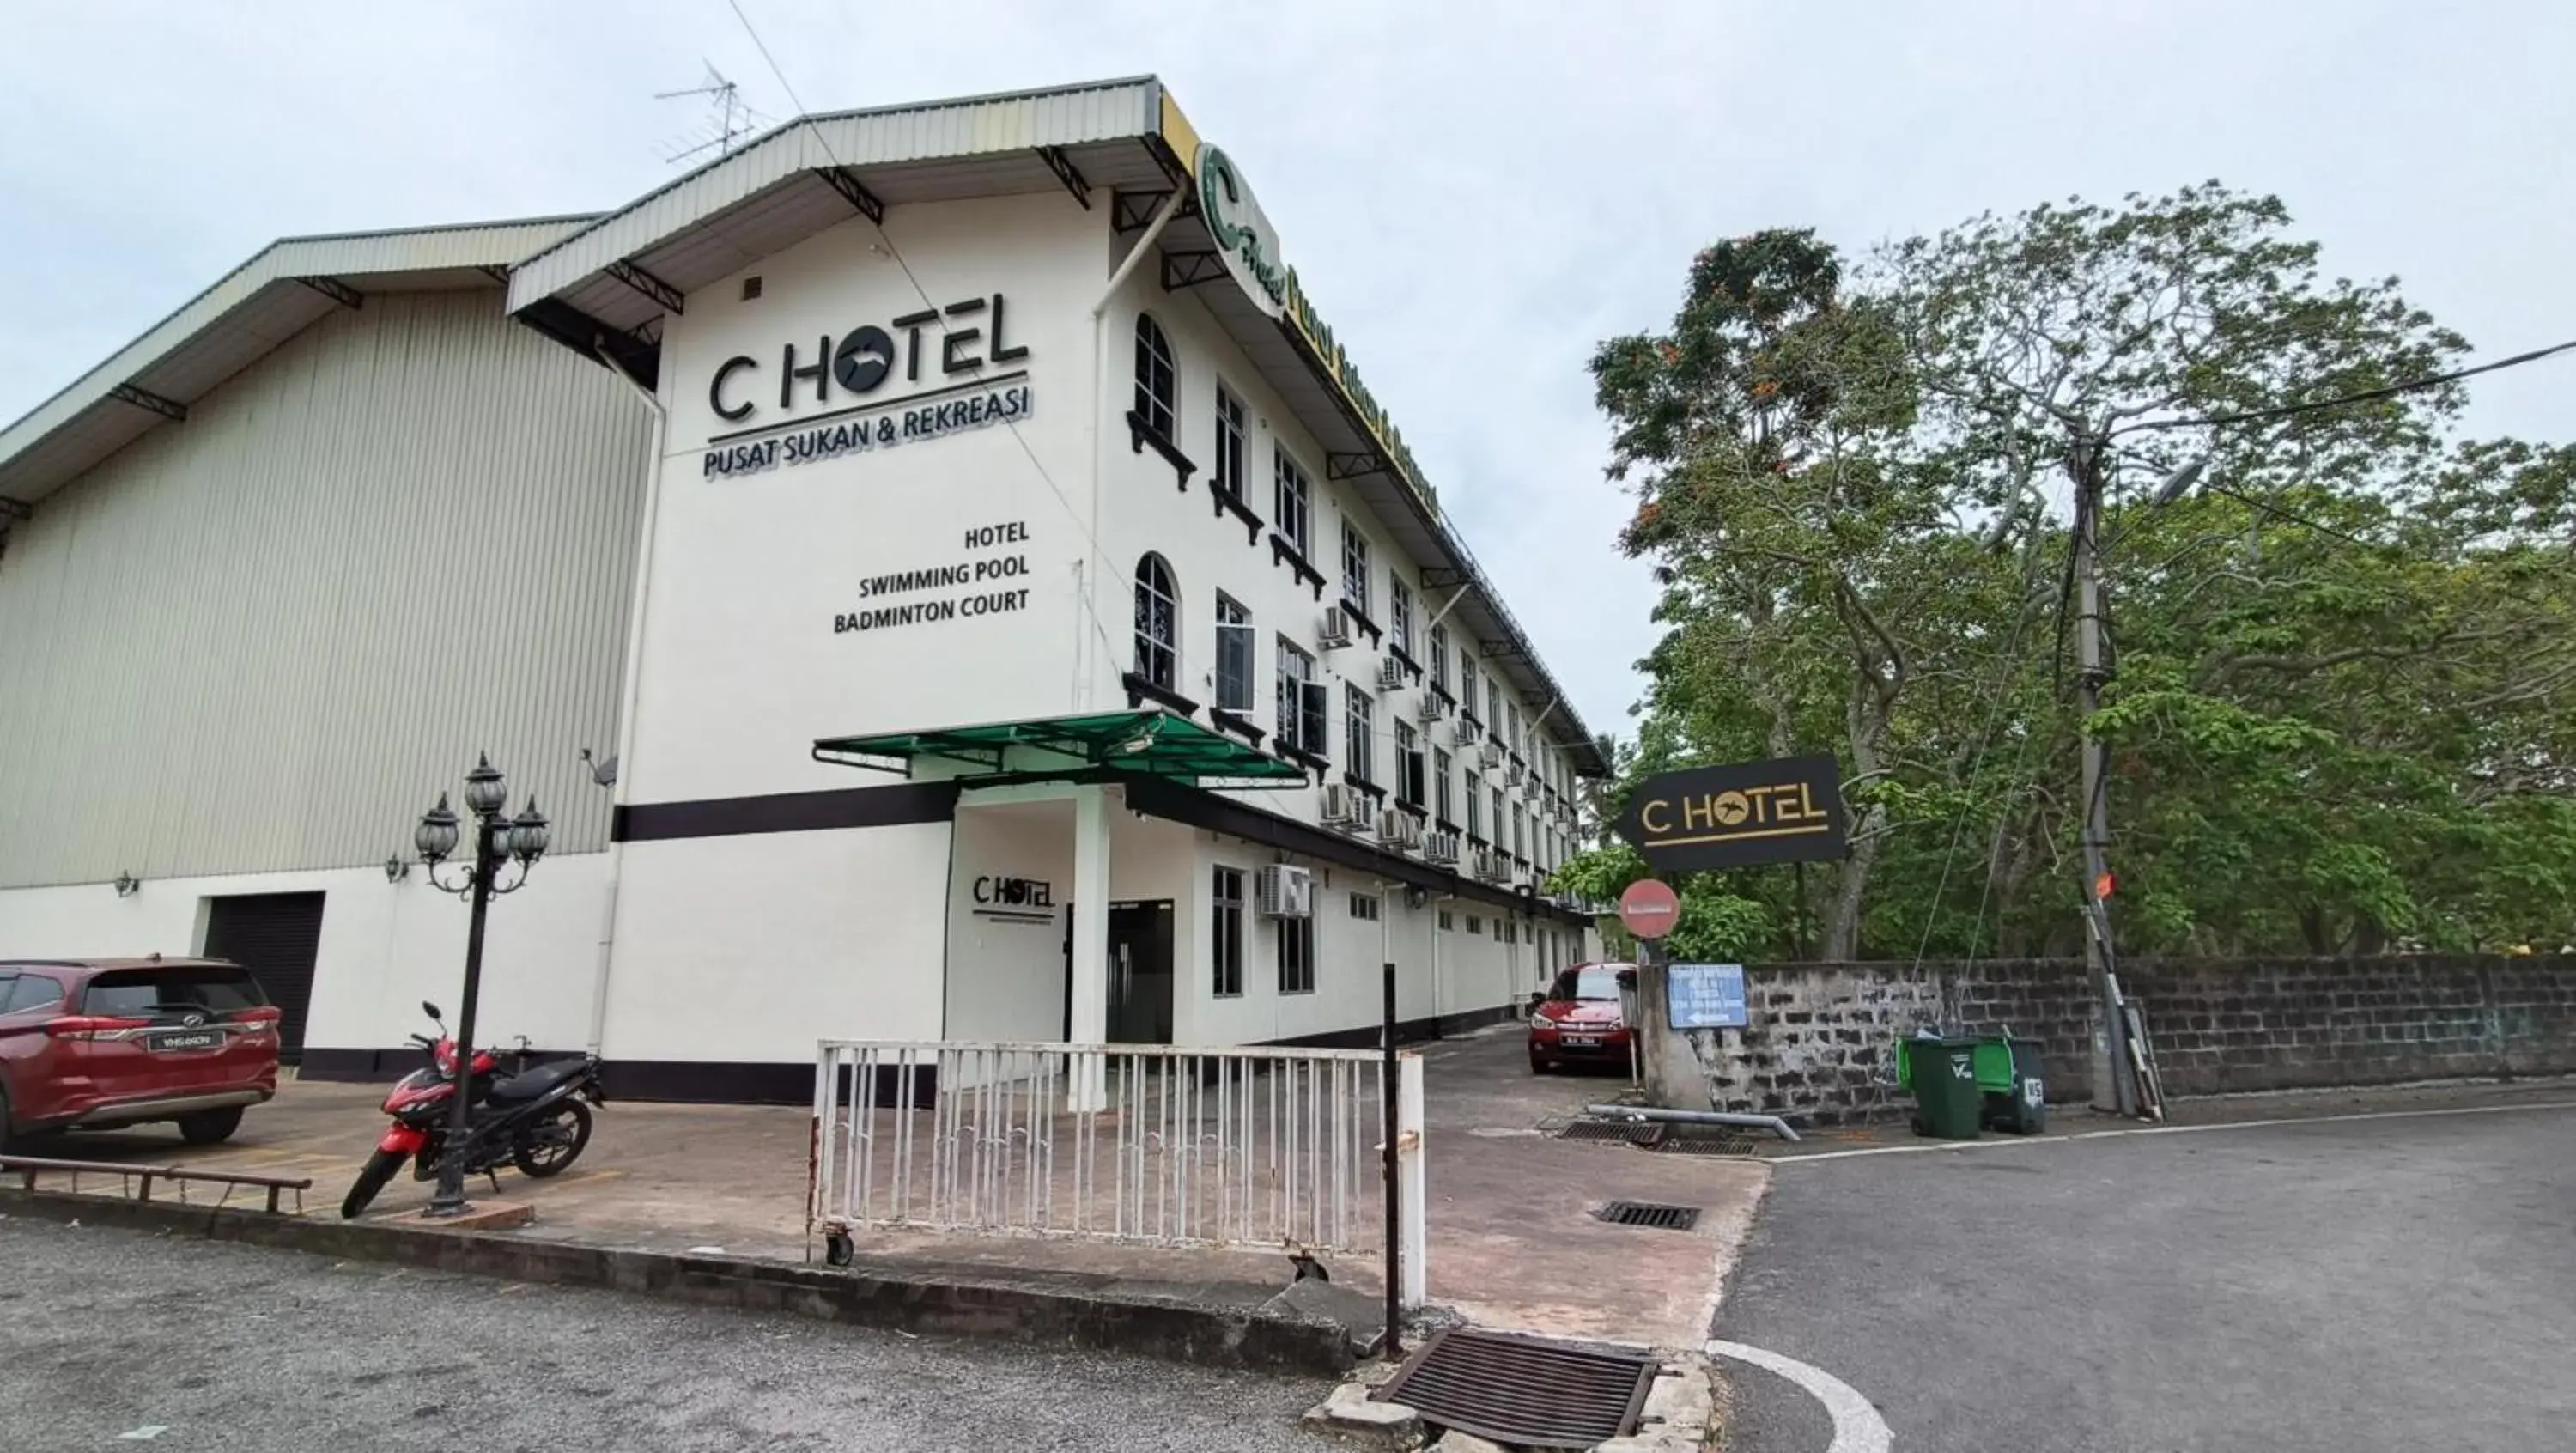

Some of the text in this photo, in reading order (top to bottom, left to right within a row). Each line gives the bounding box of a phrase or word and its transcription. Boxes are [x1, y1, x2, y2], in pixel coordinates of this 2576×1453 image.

[709, 292, 1030, 422] C HOTEL
[702, 386, 1030, 478] PUSAT SUKAN & REKREASI
[964, 520, 1030, 550] HOTEL
[859, 555, 1030, 598] SWIMMING POOL
[833, 589, 1030, 634] BADMINTON COURT
[1641, 782, 1828, 834] C HOTEL
[973, 875, 990, 903] C
